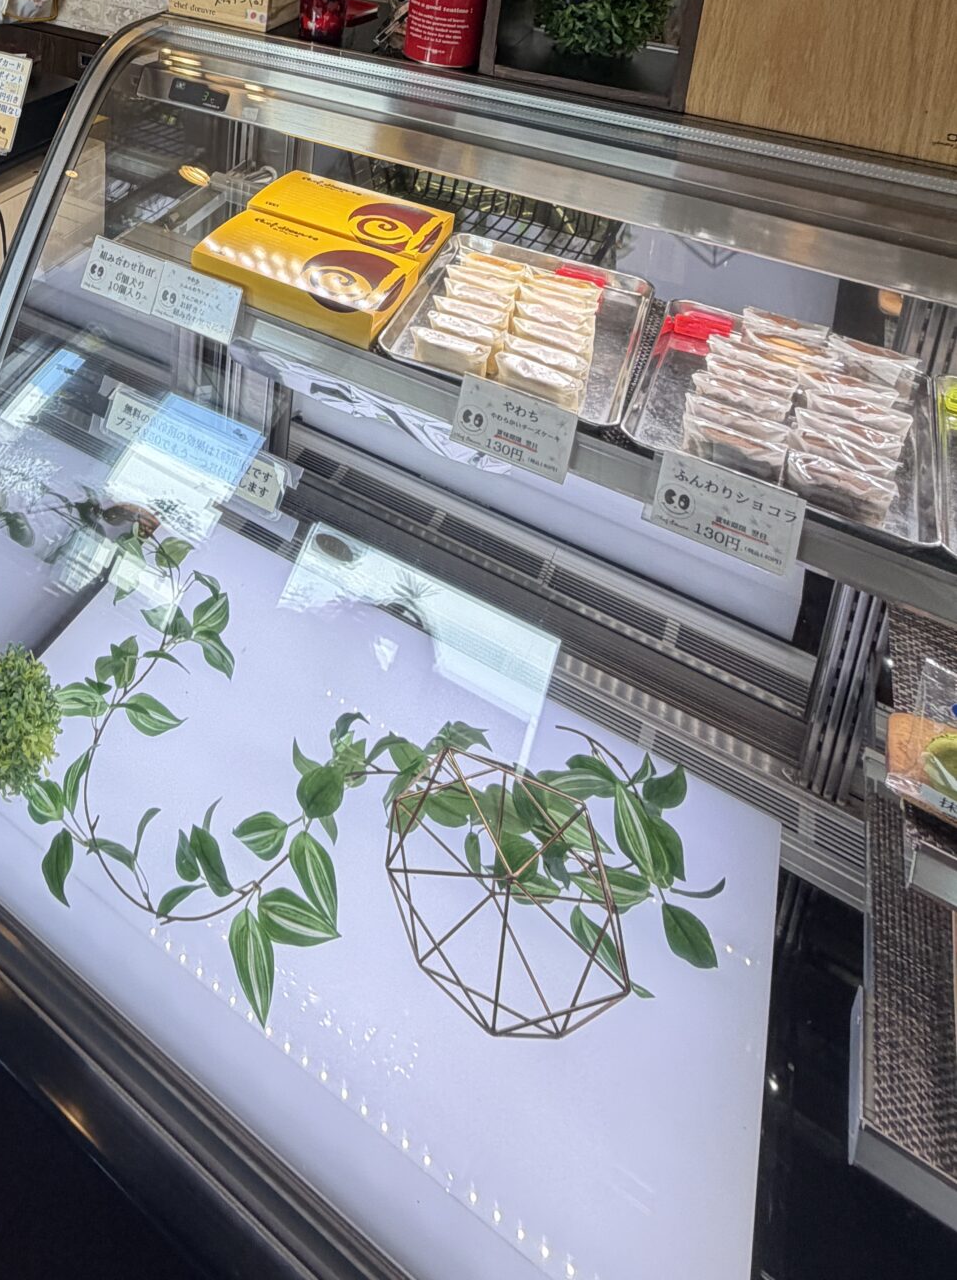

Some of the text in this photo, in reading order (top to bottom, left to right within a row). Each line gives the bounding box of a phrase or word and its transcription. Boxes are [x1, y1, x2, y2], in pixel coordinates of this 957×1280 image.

[99, 250, 155, 278] 組み合わせ自由
[504, 402, 539, 422] やわち
[485, 439, 524, 461] 130円
[674, 469, 797, 523] ふんわりショコラ
[693, 523, 740, 552] 130円
